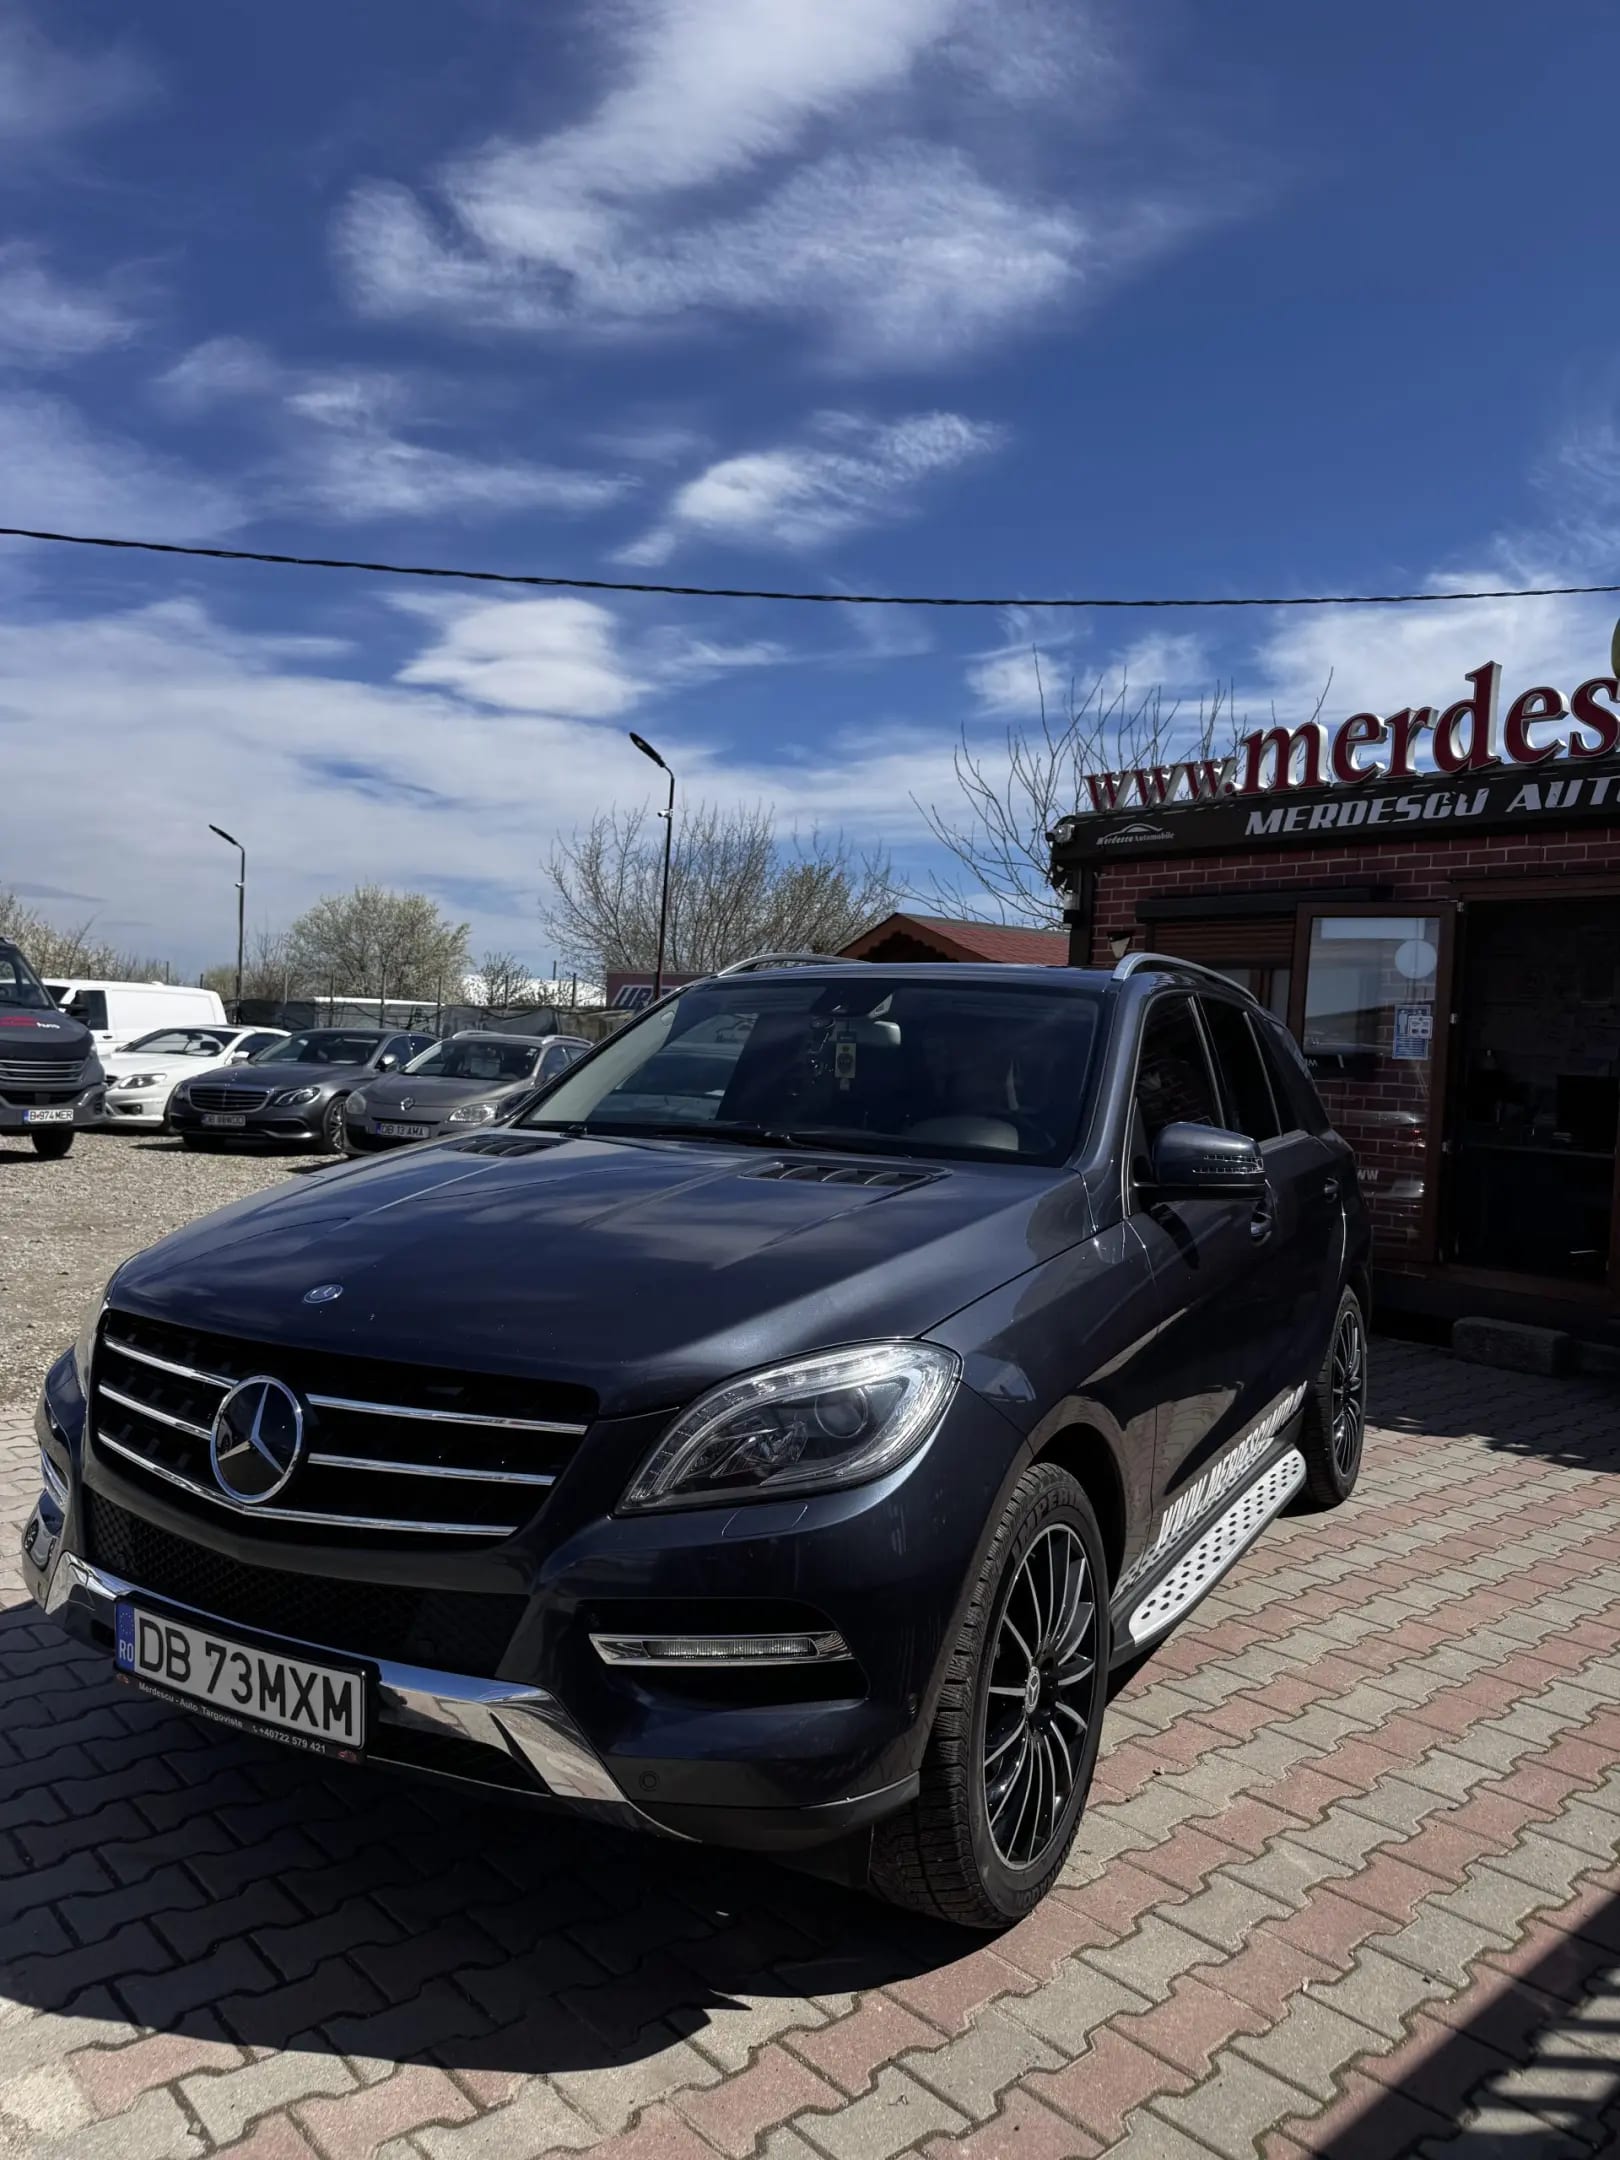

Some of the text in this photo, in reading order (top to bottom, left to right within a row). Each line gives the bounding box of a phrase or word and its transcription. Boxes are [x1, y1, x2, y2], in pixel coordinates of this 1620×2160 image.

[1245, 776, 1620, 836] MERDESCU AUT
[407, 1126, 424, 1136] AMA
[119, 1639, 135, 1663] RO
[138, 1617, 191, 1684] DB
[138, 1681, 174, 1702] Merdescu
[179, 1699, 198, 1713] Auto
[292, 1736, 308, 1749] 579
[310, 1741, 326, 1754] 421
